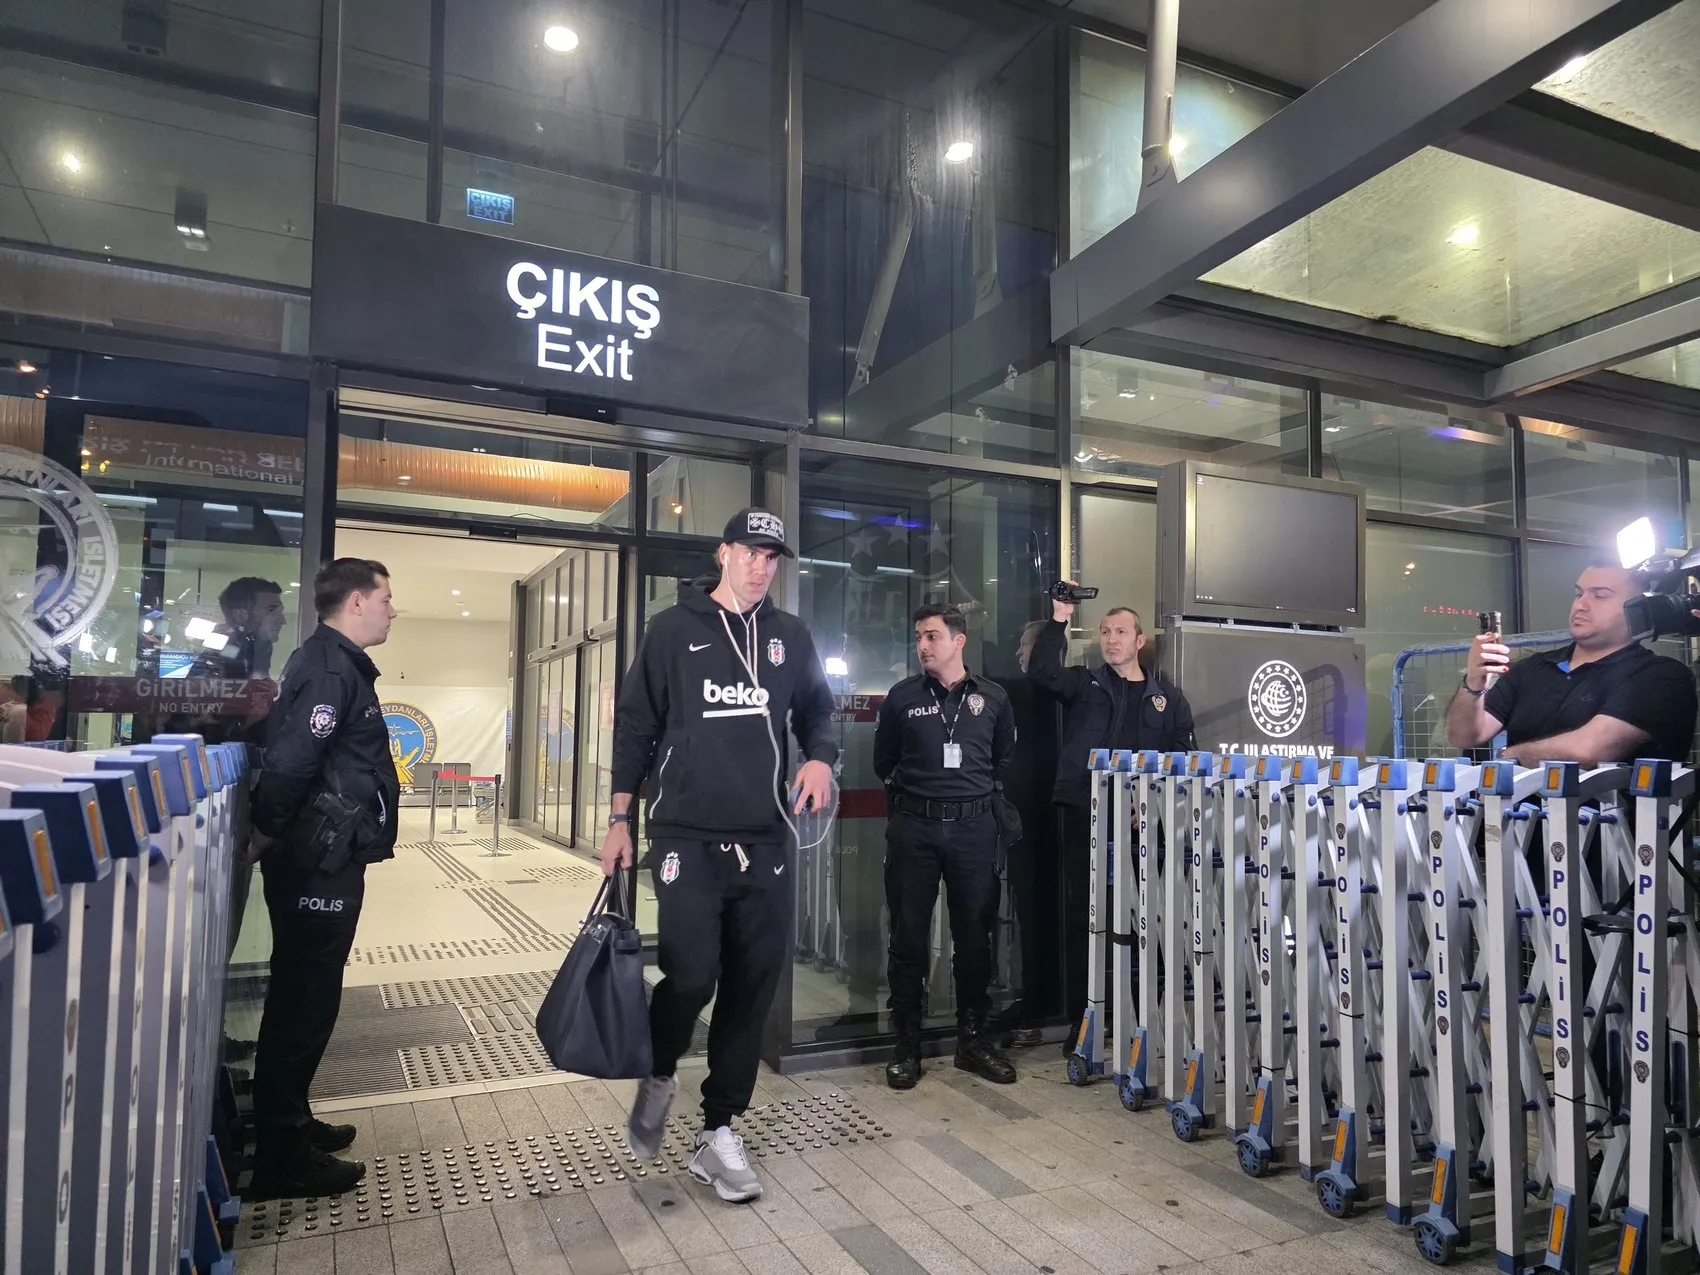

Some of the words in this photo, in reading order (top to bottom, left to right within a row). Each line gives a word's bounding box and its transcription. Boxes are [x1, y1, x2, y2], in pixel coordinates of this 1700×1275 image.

[473, 205, 507, 221] EXIT
[506, 262, 661, 339] ÇIKIŞ
[538, 323, 633, 381] Exit
[703, 679, 769, 706] beko
[159, 702, 178, 714] NO
[182, 702, 224, 714] ENTRY
[381, 704, 430, 728] EYDANLARI
